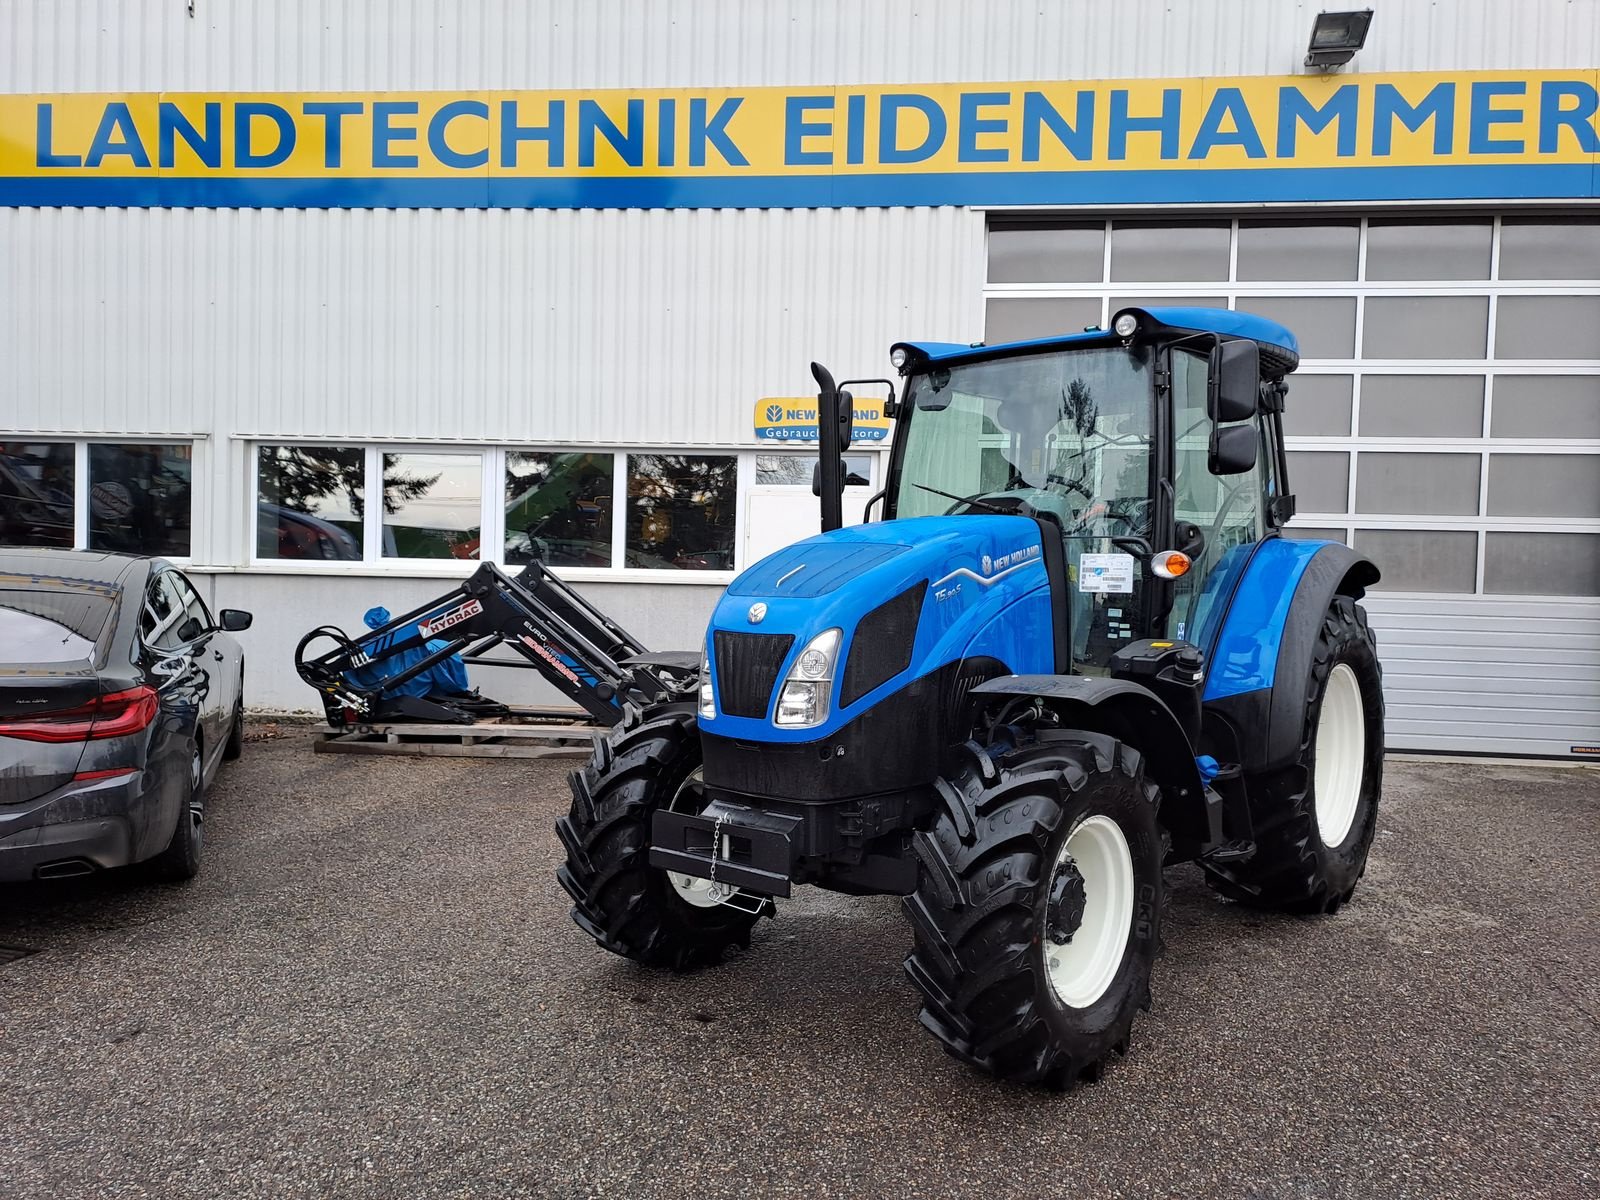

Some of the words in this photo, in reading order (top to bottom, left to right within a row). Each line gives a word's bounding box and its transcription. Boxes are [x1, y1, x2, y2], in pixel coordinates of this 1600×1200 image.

[35, 97, 751, 169] LANDTECHNIK
[784, 81, 1600, 166] EIDENHAMMER
[786, 409, 816, 420] NEW
[993, 553, 1010, 571] NEW
[1010, 544, 1040, 563] HOLLAND
[430, 604, 481, 634] HYDRAC
